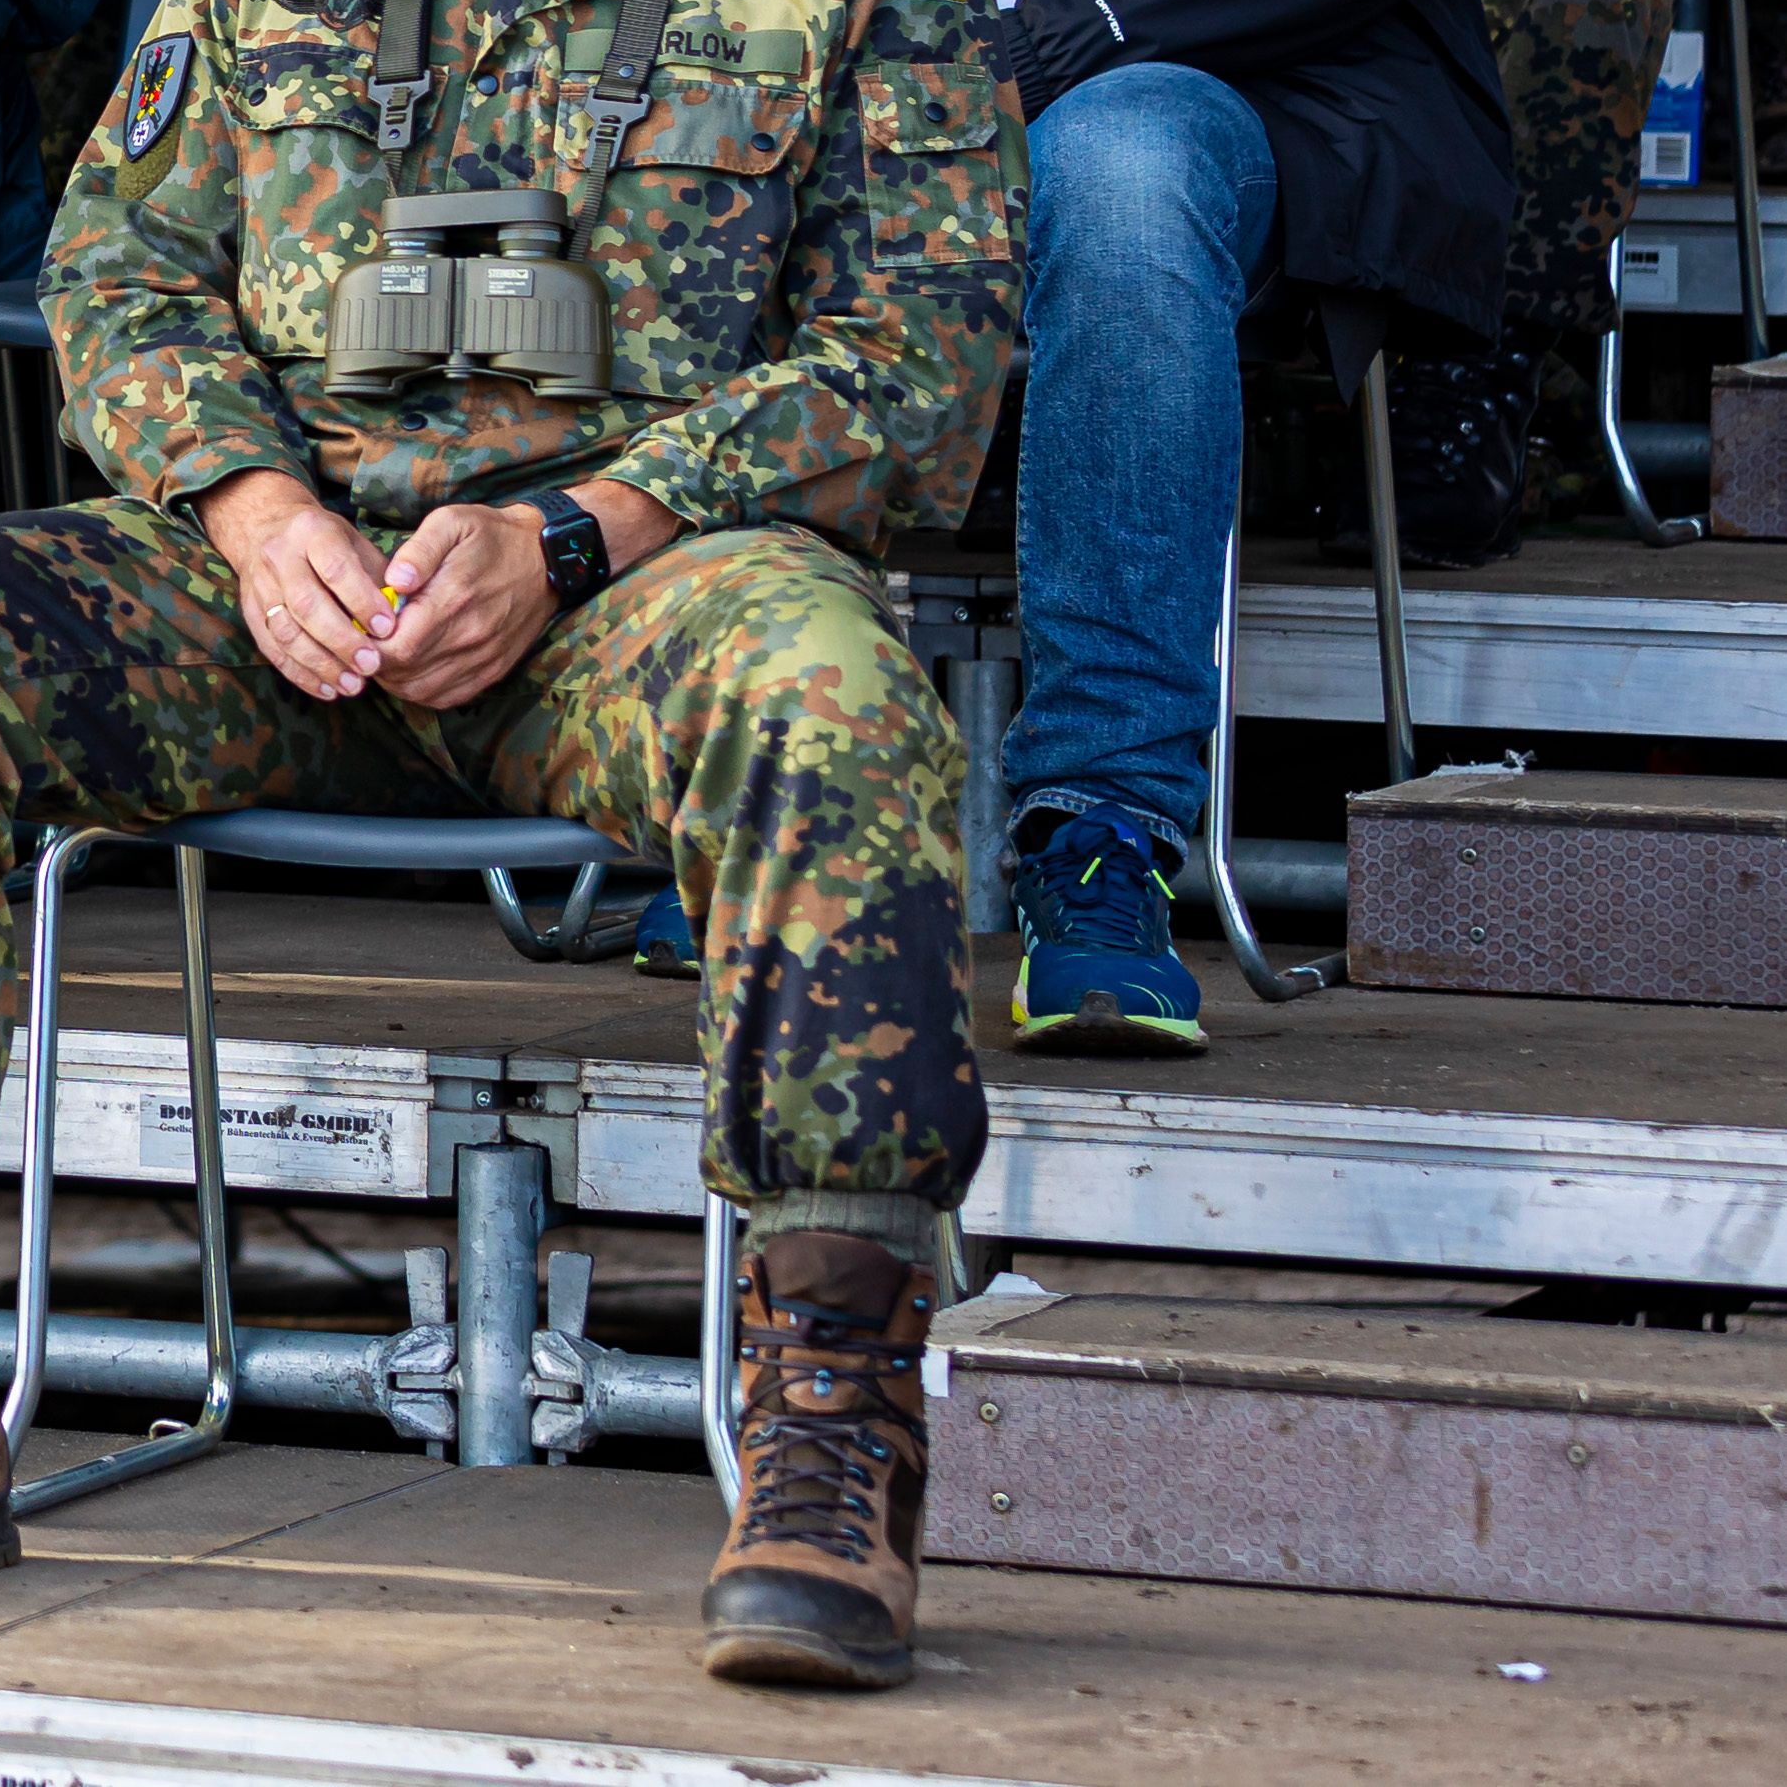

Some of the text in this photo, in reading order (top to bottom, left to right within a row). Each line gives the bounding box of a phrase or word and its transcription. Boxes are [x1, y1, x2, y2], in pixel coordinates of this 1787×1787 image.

[658, 30, 746, 63] RLOW
[160, 1104, 193, 1120] DO
[291, 1132, 300, 1141] &
[302, 1133, 369, 1146] Eventgüstbau
[0, 1774, 54, 1787] DOC
